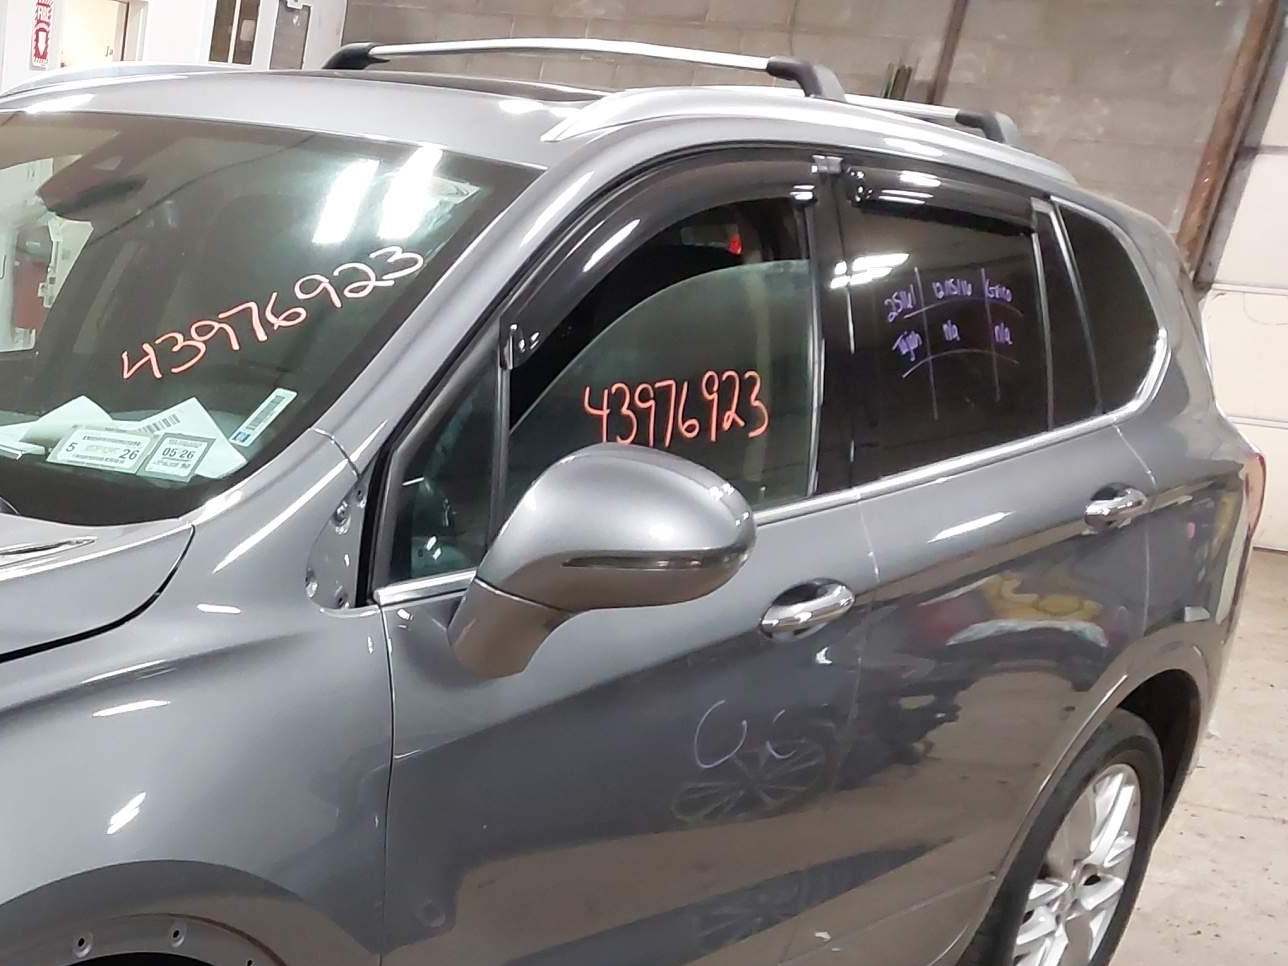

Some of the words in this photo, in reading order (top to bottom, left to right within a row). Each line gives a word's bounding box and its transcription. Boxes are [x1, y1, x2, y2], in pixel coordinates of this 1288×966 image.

[122, 245, 424, 380] 43976923
[584, 370, 769, 448] 43976923
[118, 448, 140, 461] 26
[161, 446, 177, 458] 05
[178, 449, 195, 460] 26
